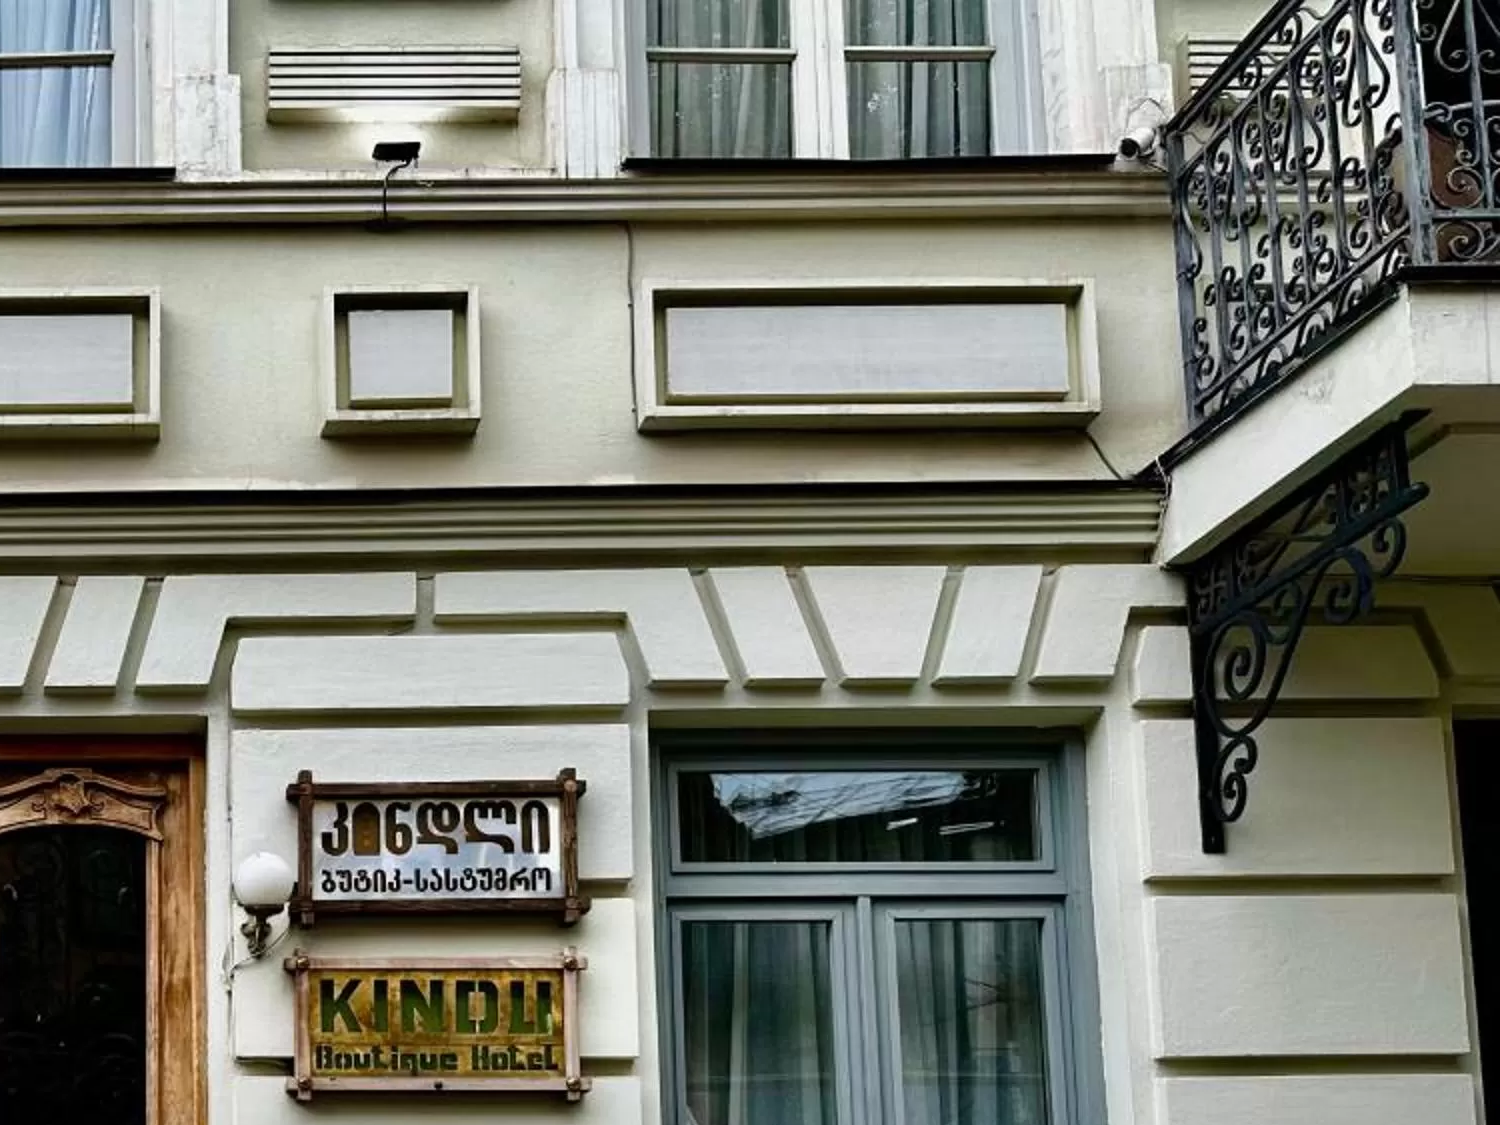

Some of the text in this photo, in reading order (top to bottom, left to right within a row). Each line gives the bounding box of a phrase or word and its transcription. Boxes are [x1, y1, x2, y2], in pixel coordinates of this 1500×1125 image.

[321, 800, 551, 856] კინდლი
[321, 868, 552, 893] ბუტიკ-სასტუმრო
[315, 1044, 558, 1075] Boutique Hotel
